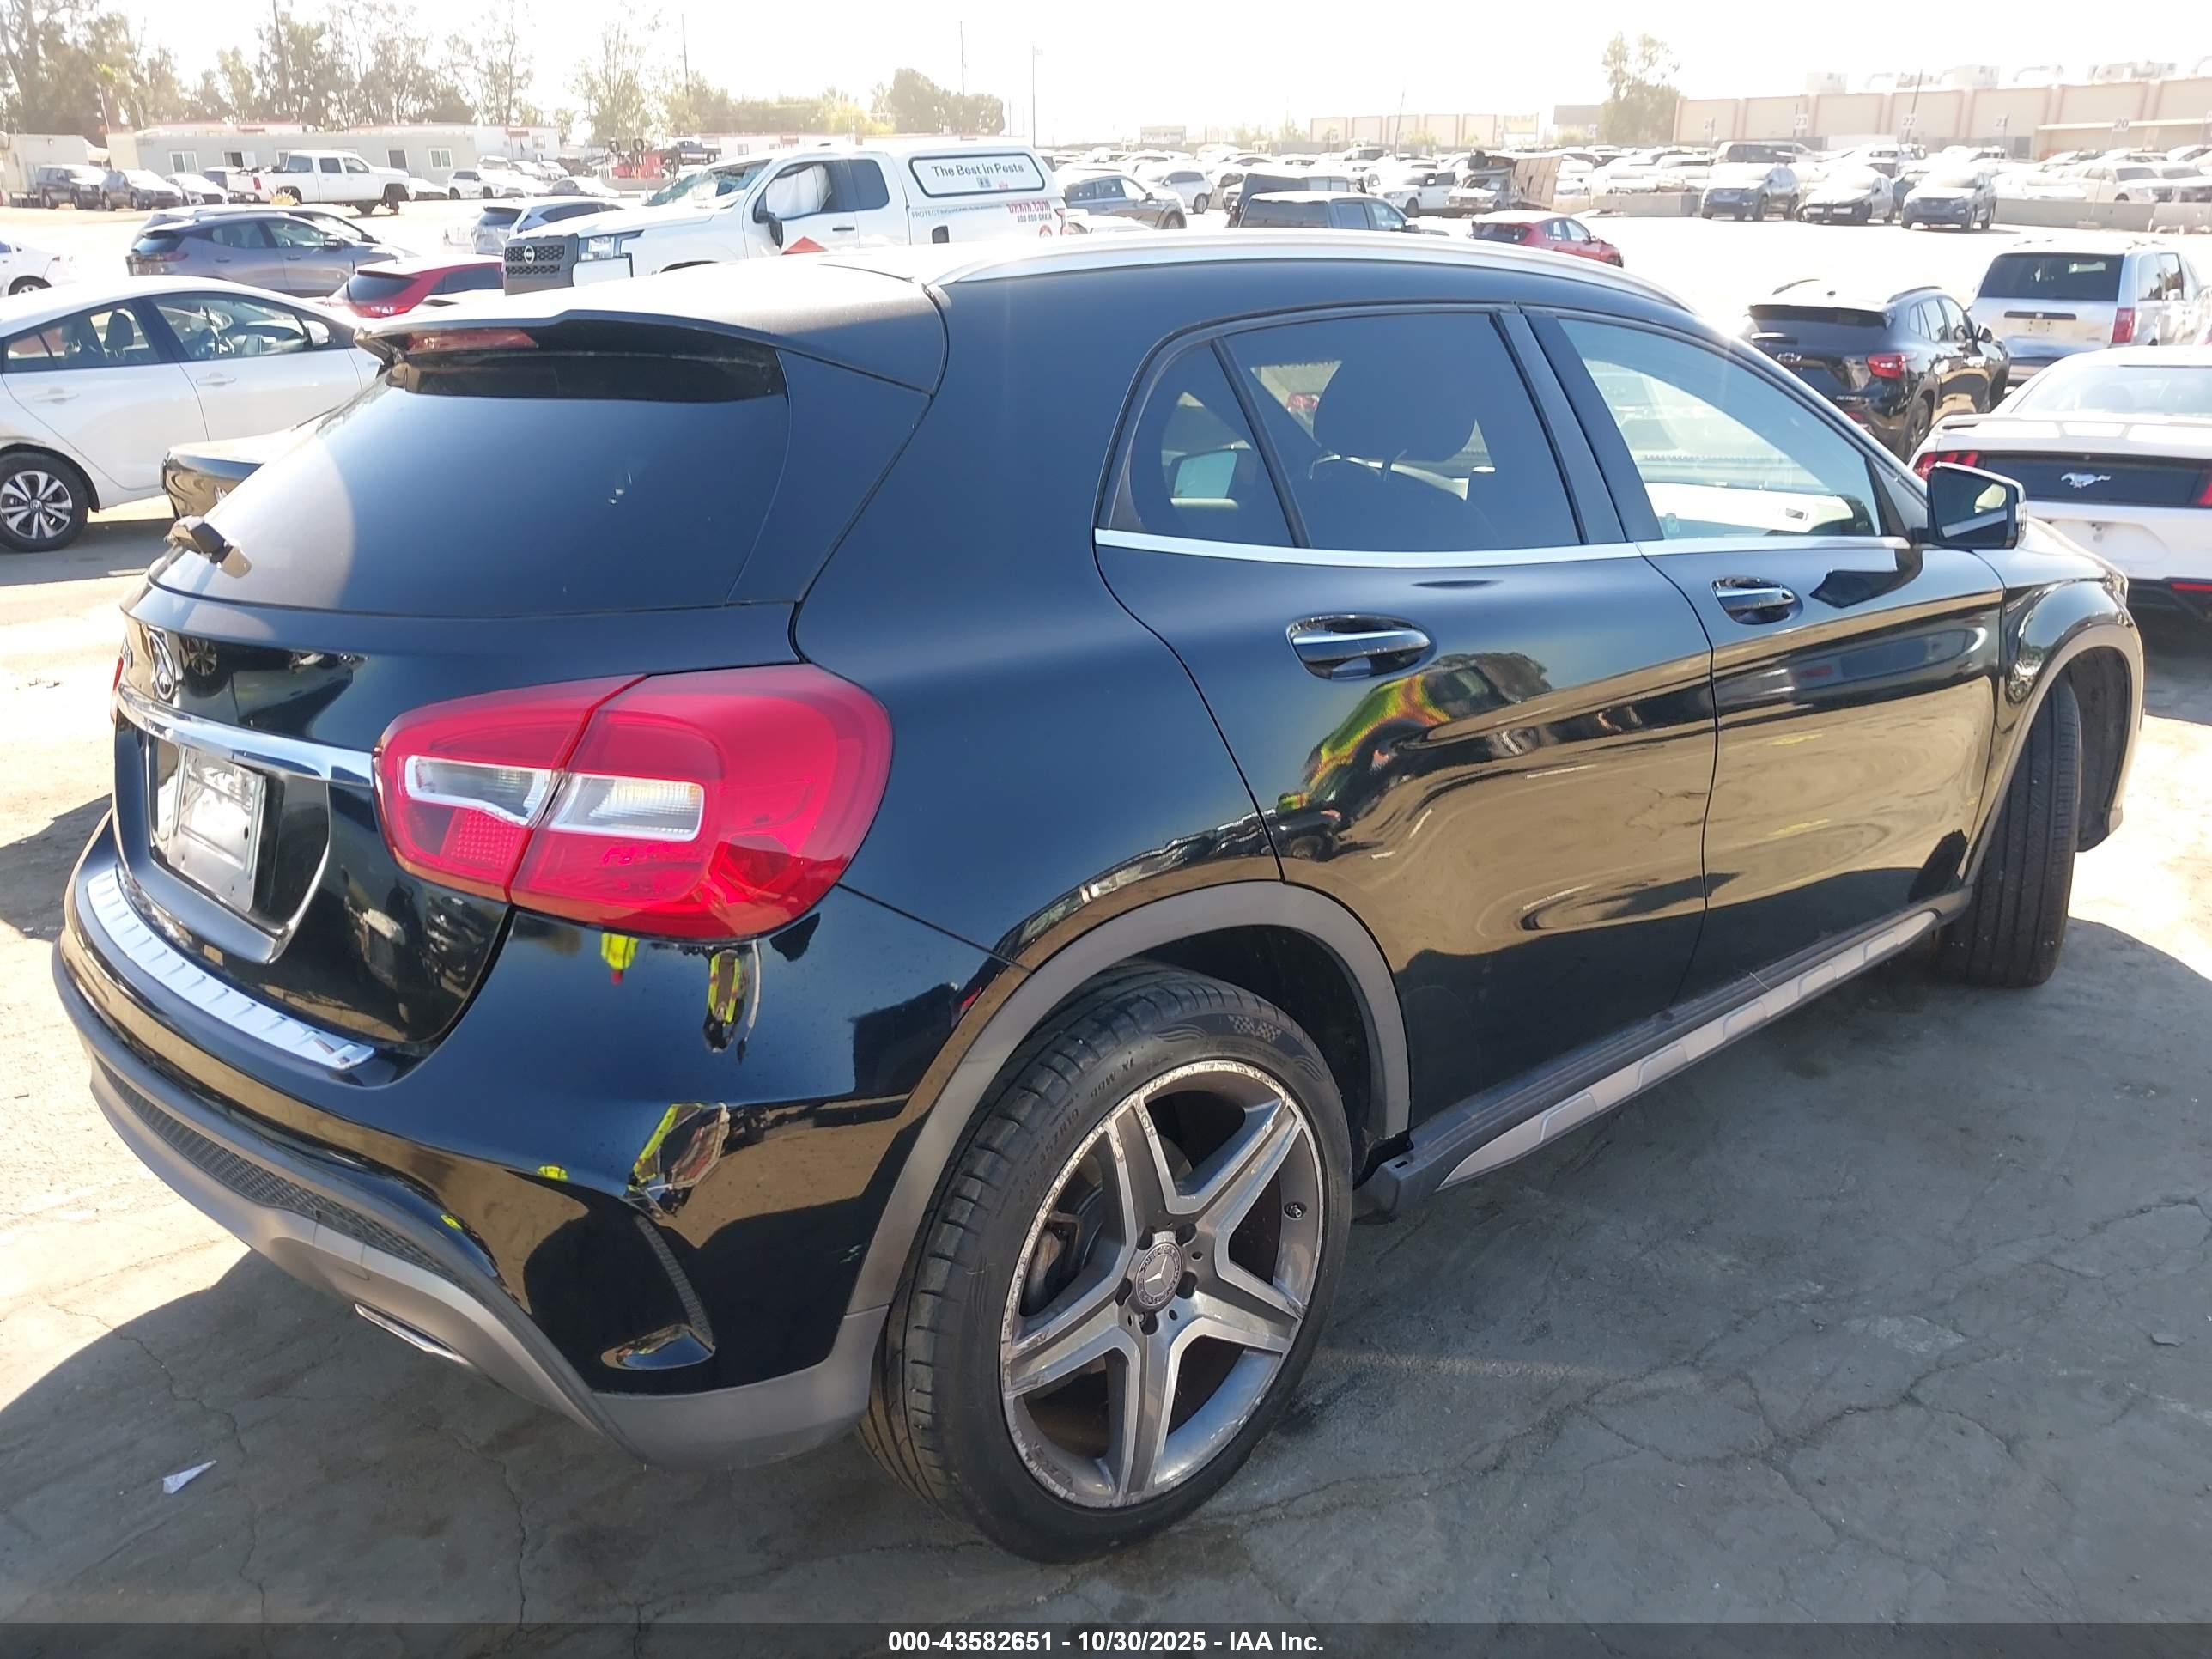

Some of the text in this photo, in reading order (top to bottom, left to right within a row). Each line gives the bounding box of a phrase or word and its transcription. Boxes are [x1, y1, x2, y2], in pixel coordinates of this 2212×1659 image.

[1903, 116, 1917, 126] 22
[2114, 118, 2129, 129] 20
[932, 162, 1024, 177] The Best in Pests
